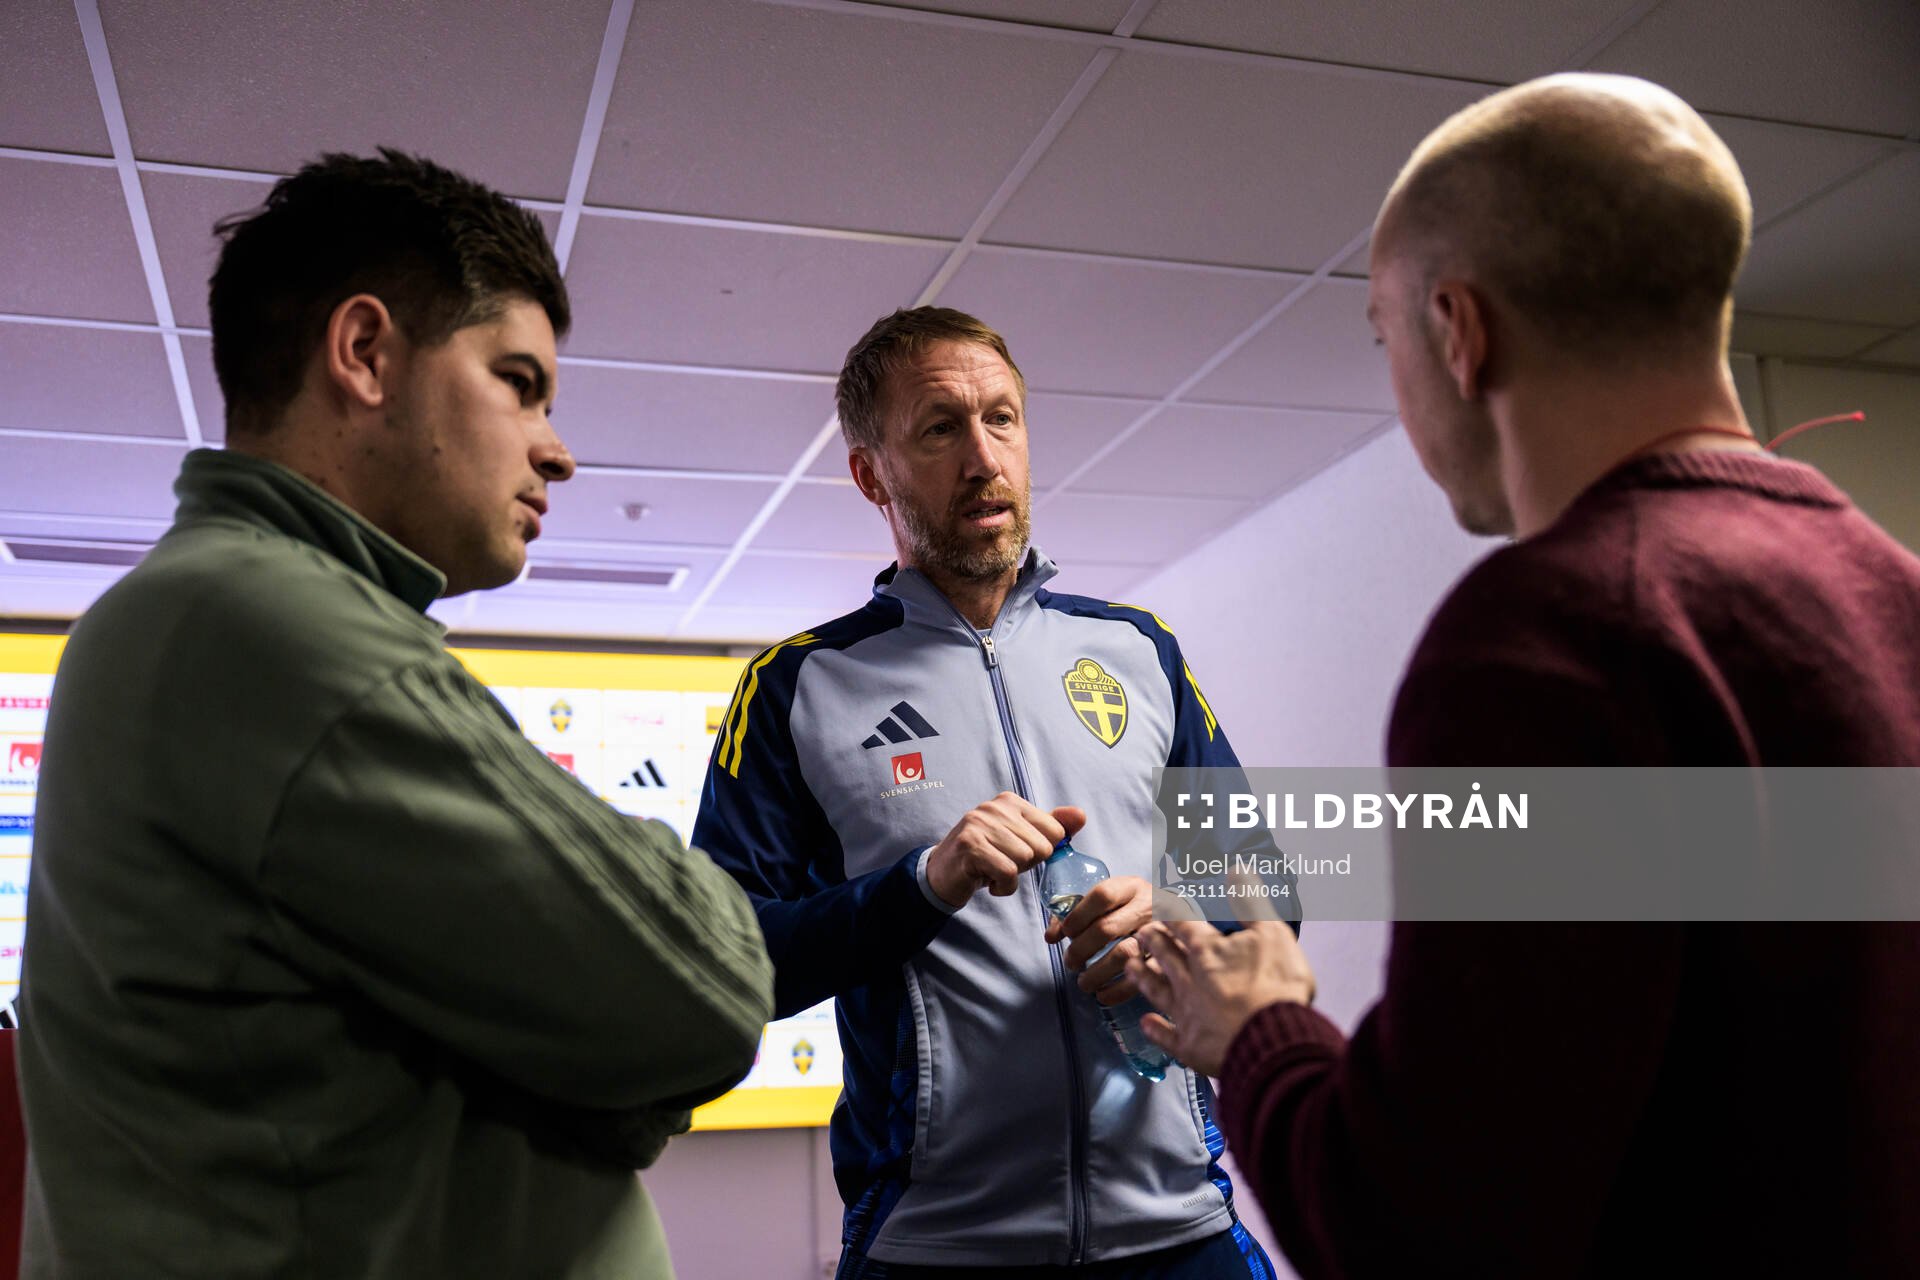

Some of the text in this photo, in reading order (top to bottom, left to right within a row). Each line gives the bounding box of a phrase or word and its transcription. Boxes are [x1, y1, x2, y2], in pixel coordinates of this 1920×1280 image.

[1074, 682, 1115, 693] SVERIGE
[880, 780, 945, 799] SVENSKA SPEL
